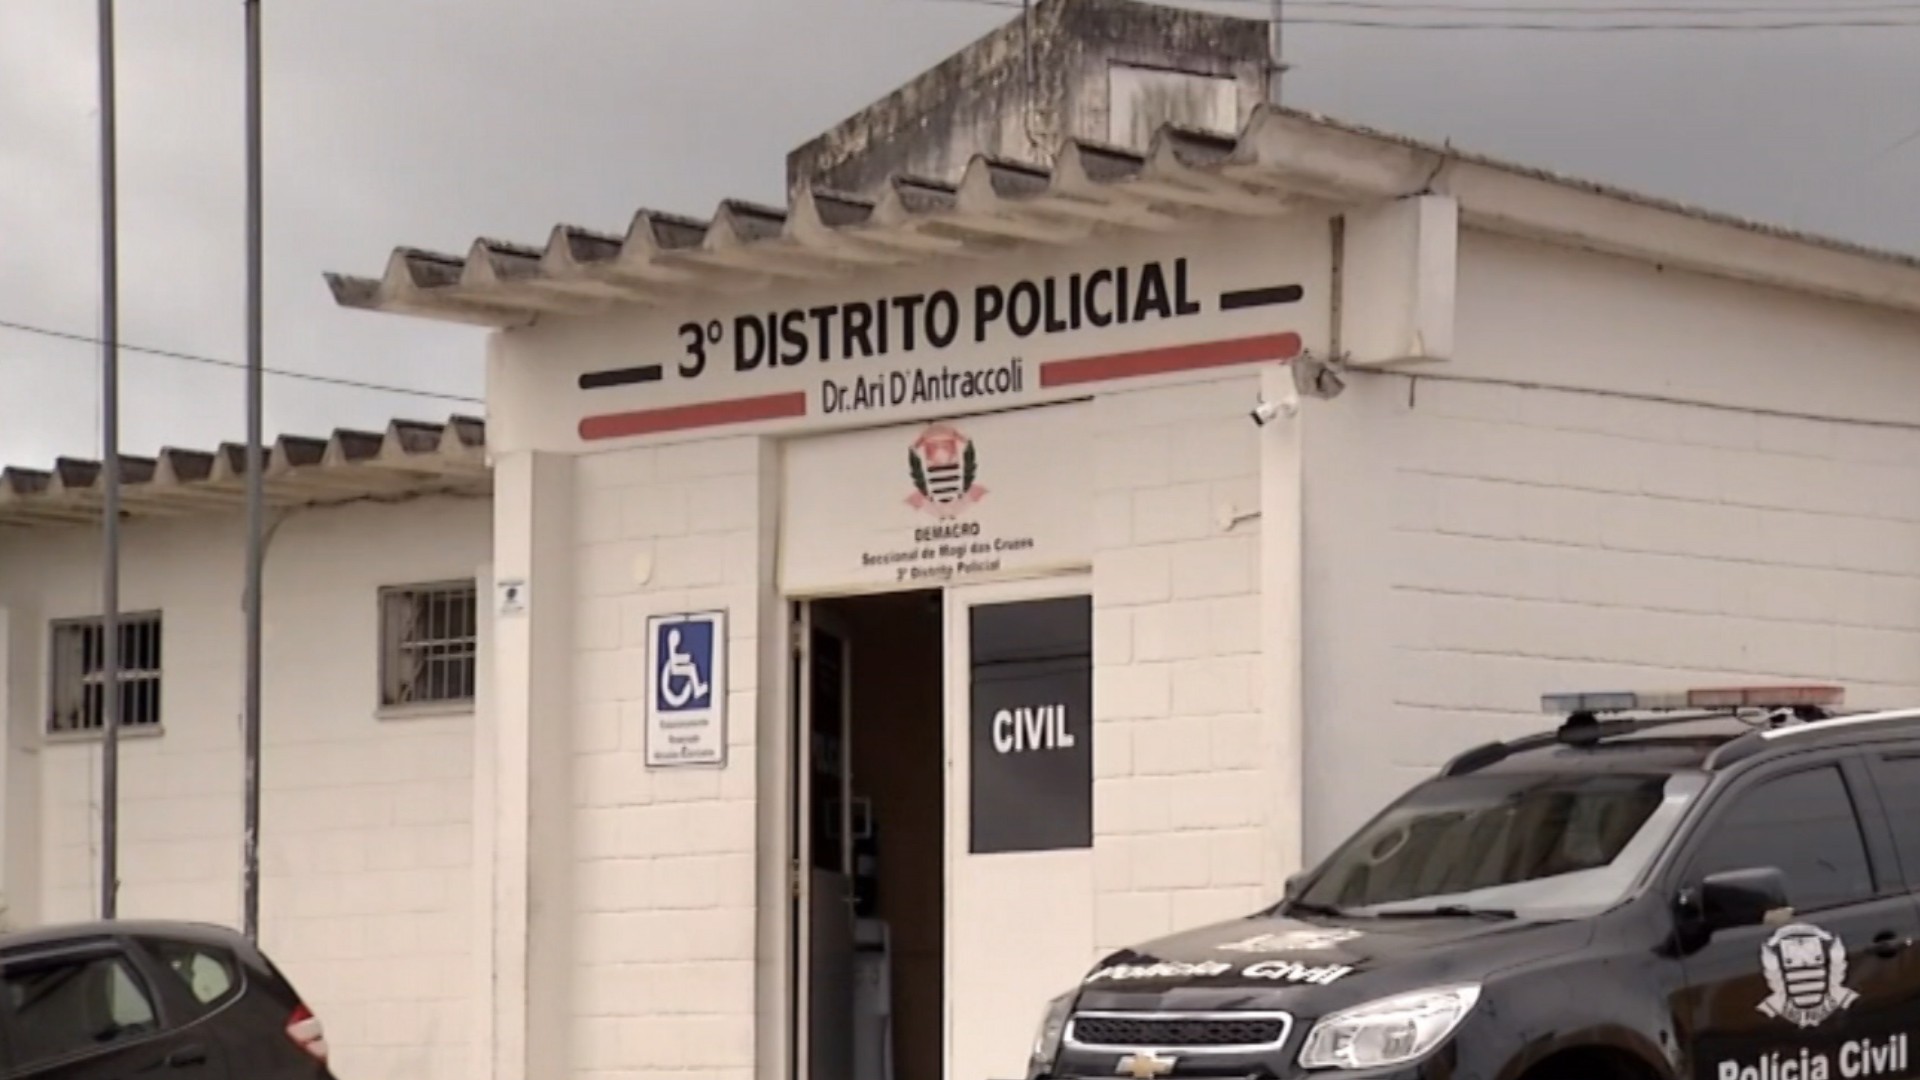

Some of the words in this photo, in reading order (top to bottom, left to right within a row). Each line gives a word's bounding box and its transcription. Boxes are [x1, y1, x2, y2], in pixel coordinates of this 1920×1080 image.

[733, 289, 960, 371] DISTRITO
[974, 257, 1200, 343] POLICIAL
[914, 521, 981, 542] DEMACRO
[992, 704, 1075, 753] CIVIL
[1838, 1032, 1907, 1078] Civil
